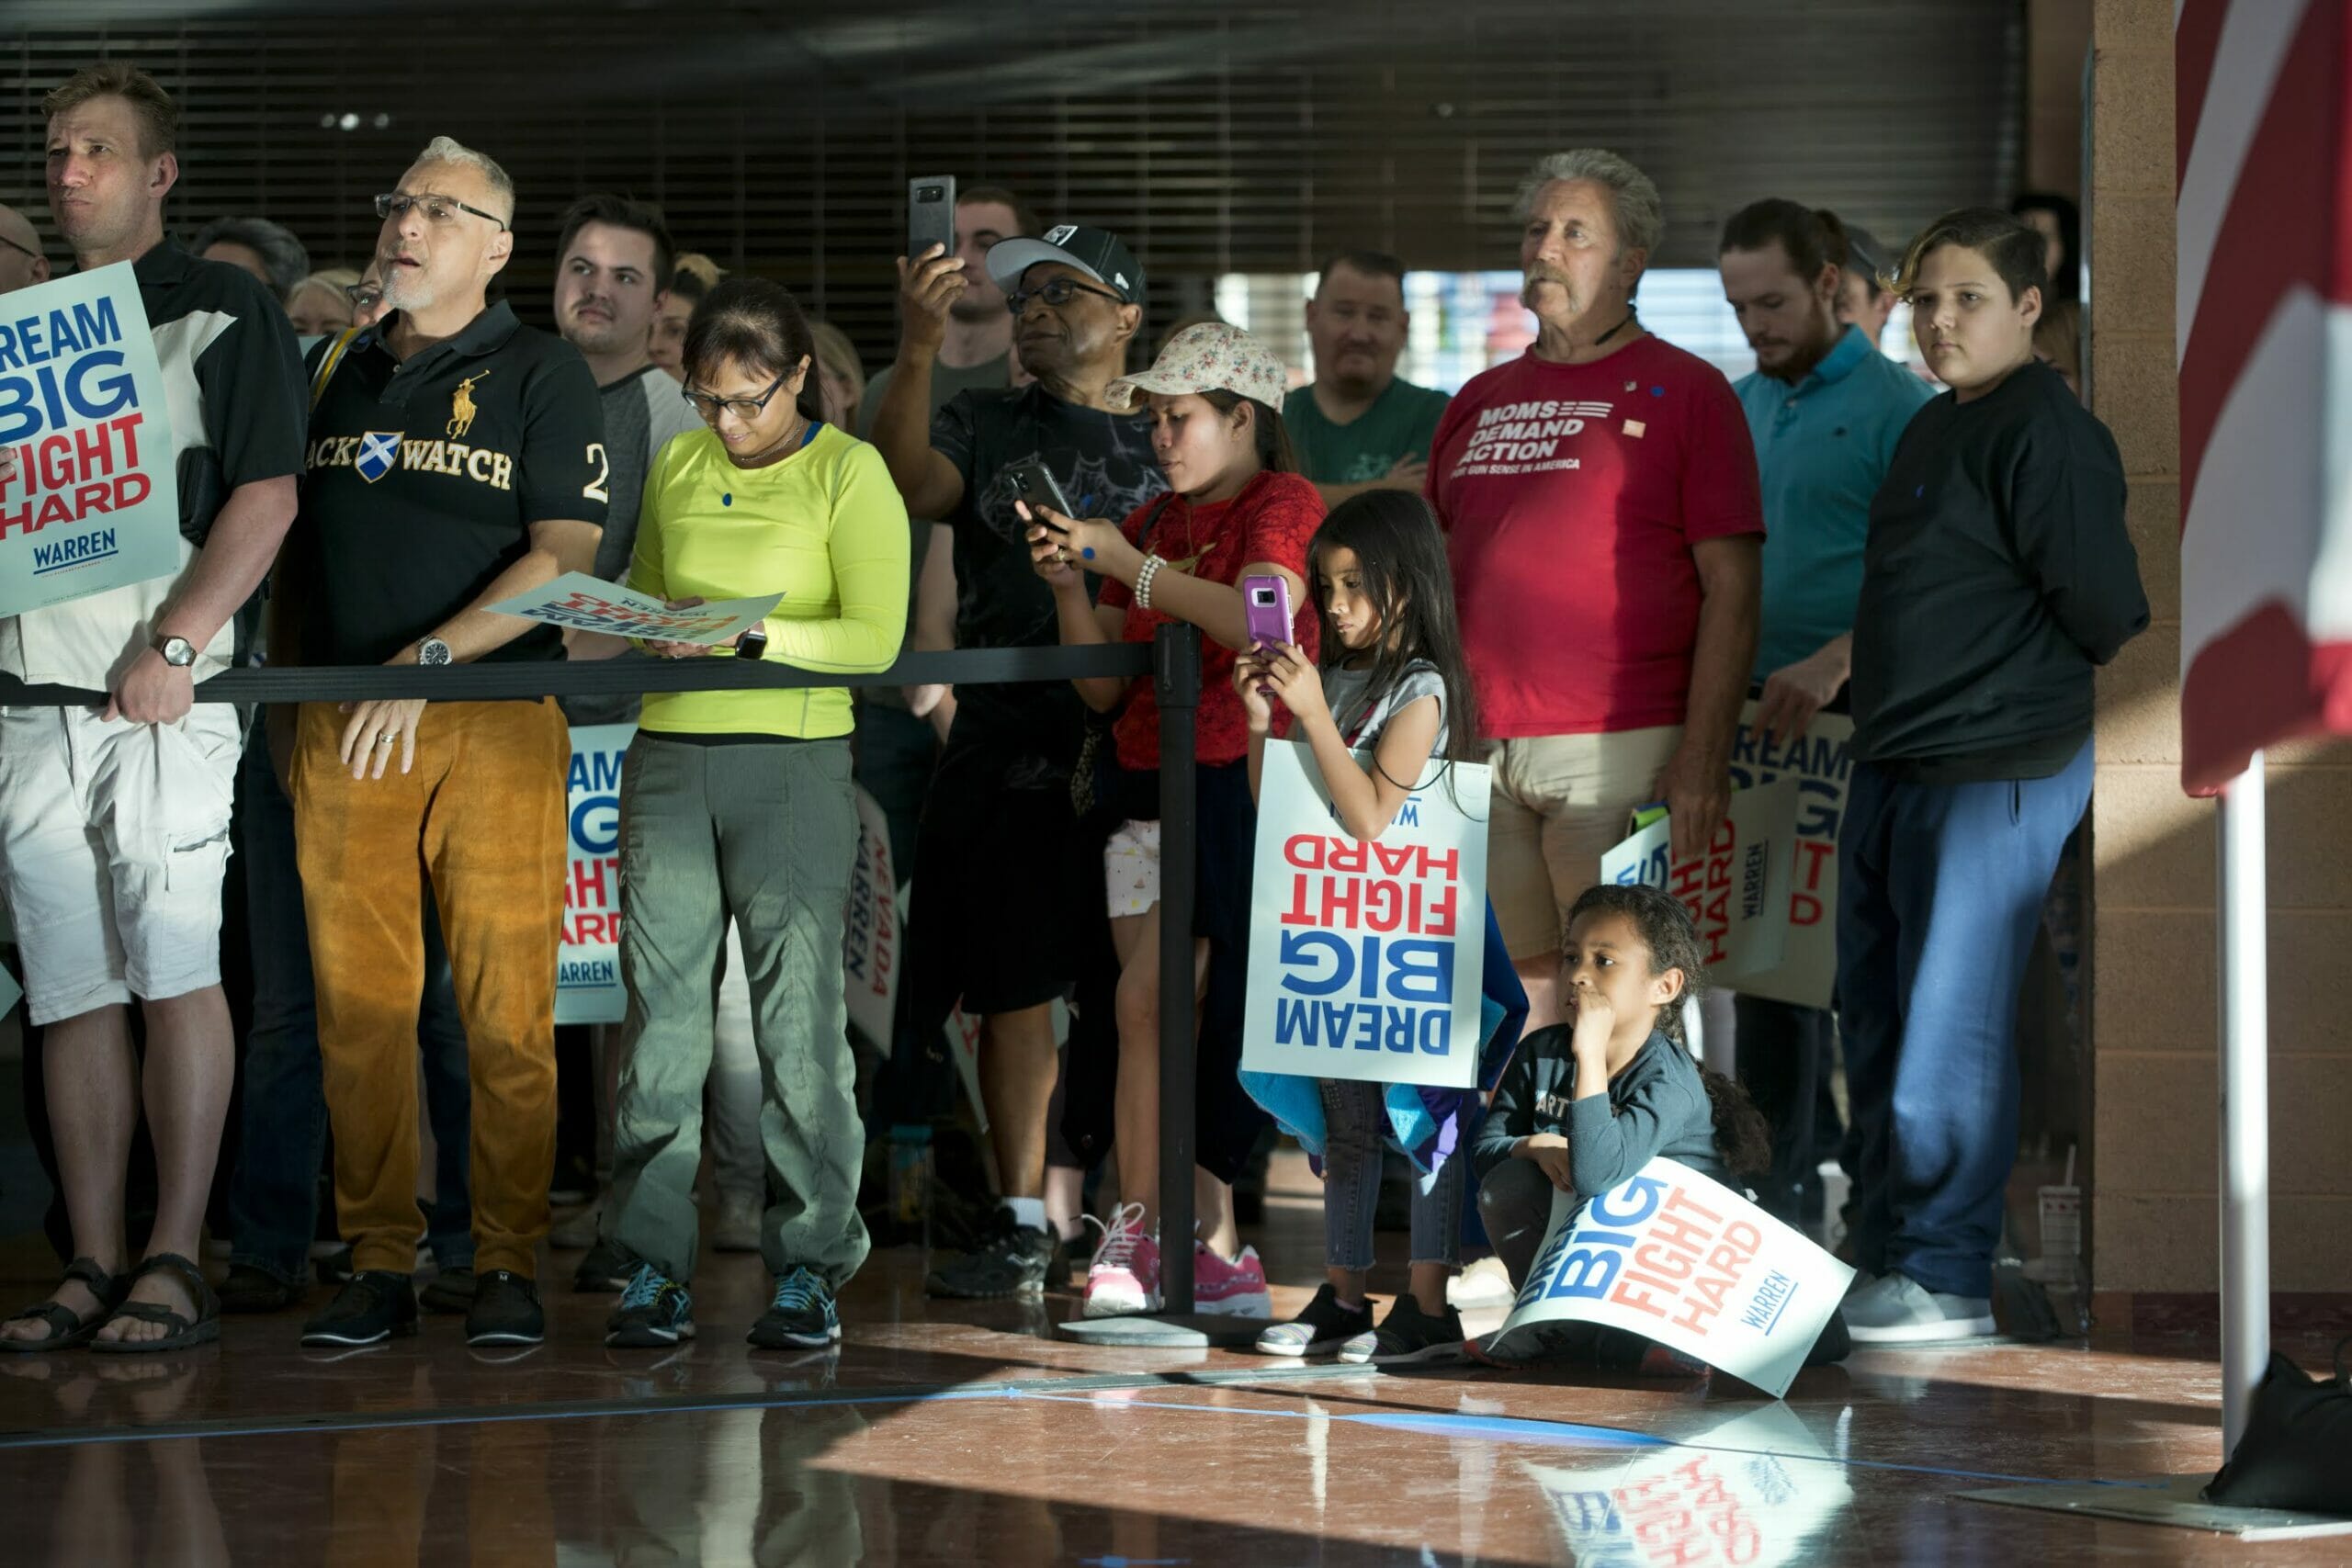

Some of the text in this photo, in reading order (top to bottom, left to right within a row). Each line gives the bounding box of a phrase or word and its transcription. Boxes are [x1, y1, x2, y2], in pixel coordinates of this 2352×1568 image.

[1467, 418, 1585, 449] DEMAND
[1477, 400, 1559, 428] MOMS
[401, 438, 514, 491] WATCH
[582, 443, 609, 504] 2
[1456, 438, 1559, 467] ACTION
[1467, 464, 1488, 475] GUN
[1488, 464, 1521, 475] SENSE
[1521, 463, 1533, 474] IN
[1532, 458, 1580, 472] AMERICA
[0, 472, 152, 540] HARD
[33, 527, 116, 568] WARREN
[1283, 833, 1460, 882] HARD
[1741, 841, 1763, 921] WARREN
[872, 834, 894, 998] NEVADA
[1280, 874, 1459, 937] FIGHT
[1279, 930, 1456, 1005] BIG
[1275, 998, 1452, 1056] DREAM
[1545, 1175, 1669, 1300] BIG
[1610, 1185, 1724, 1318] FIGHT
[1671, 1219, 1763, 1337] HARD
[1741, 1269, 1792, 1330] WARREN
